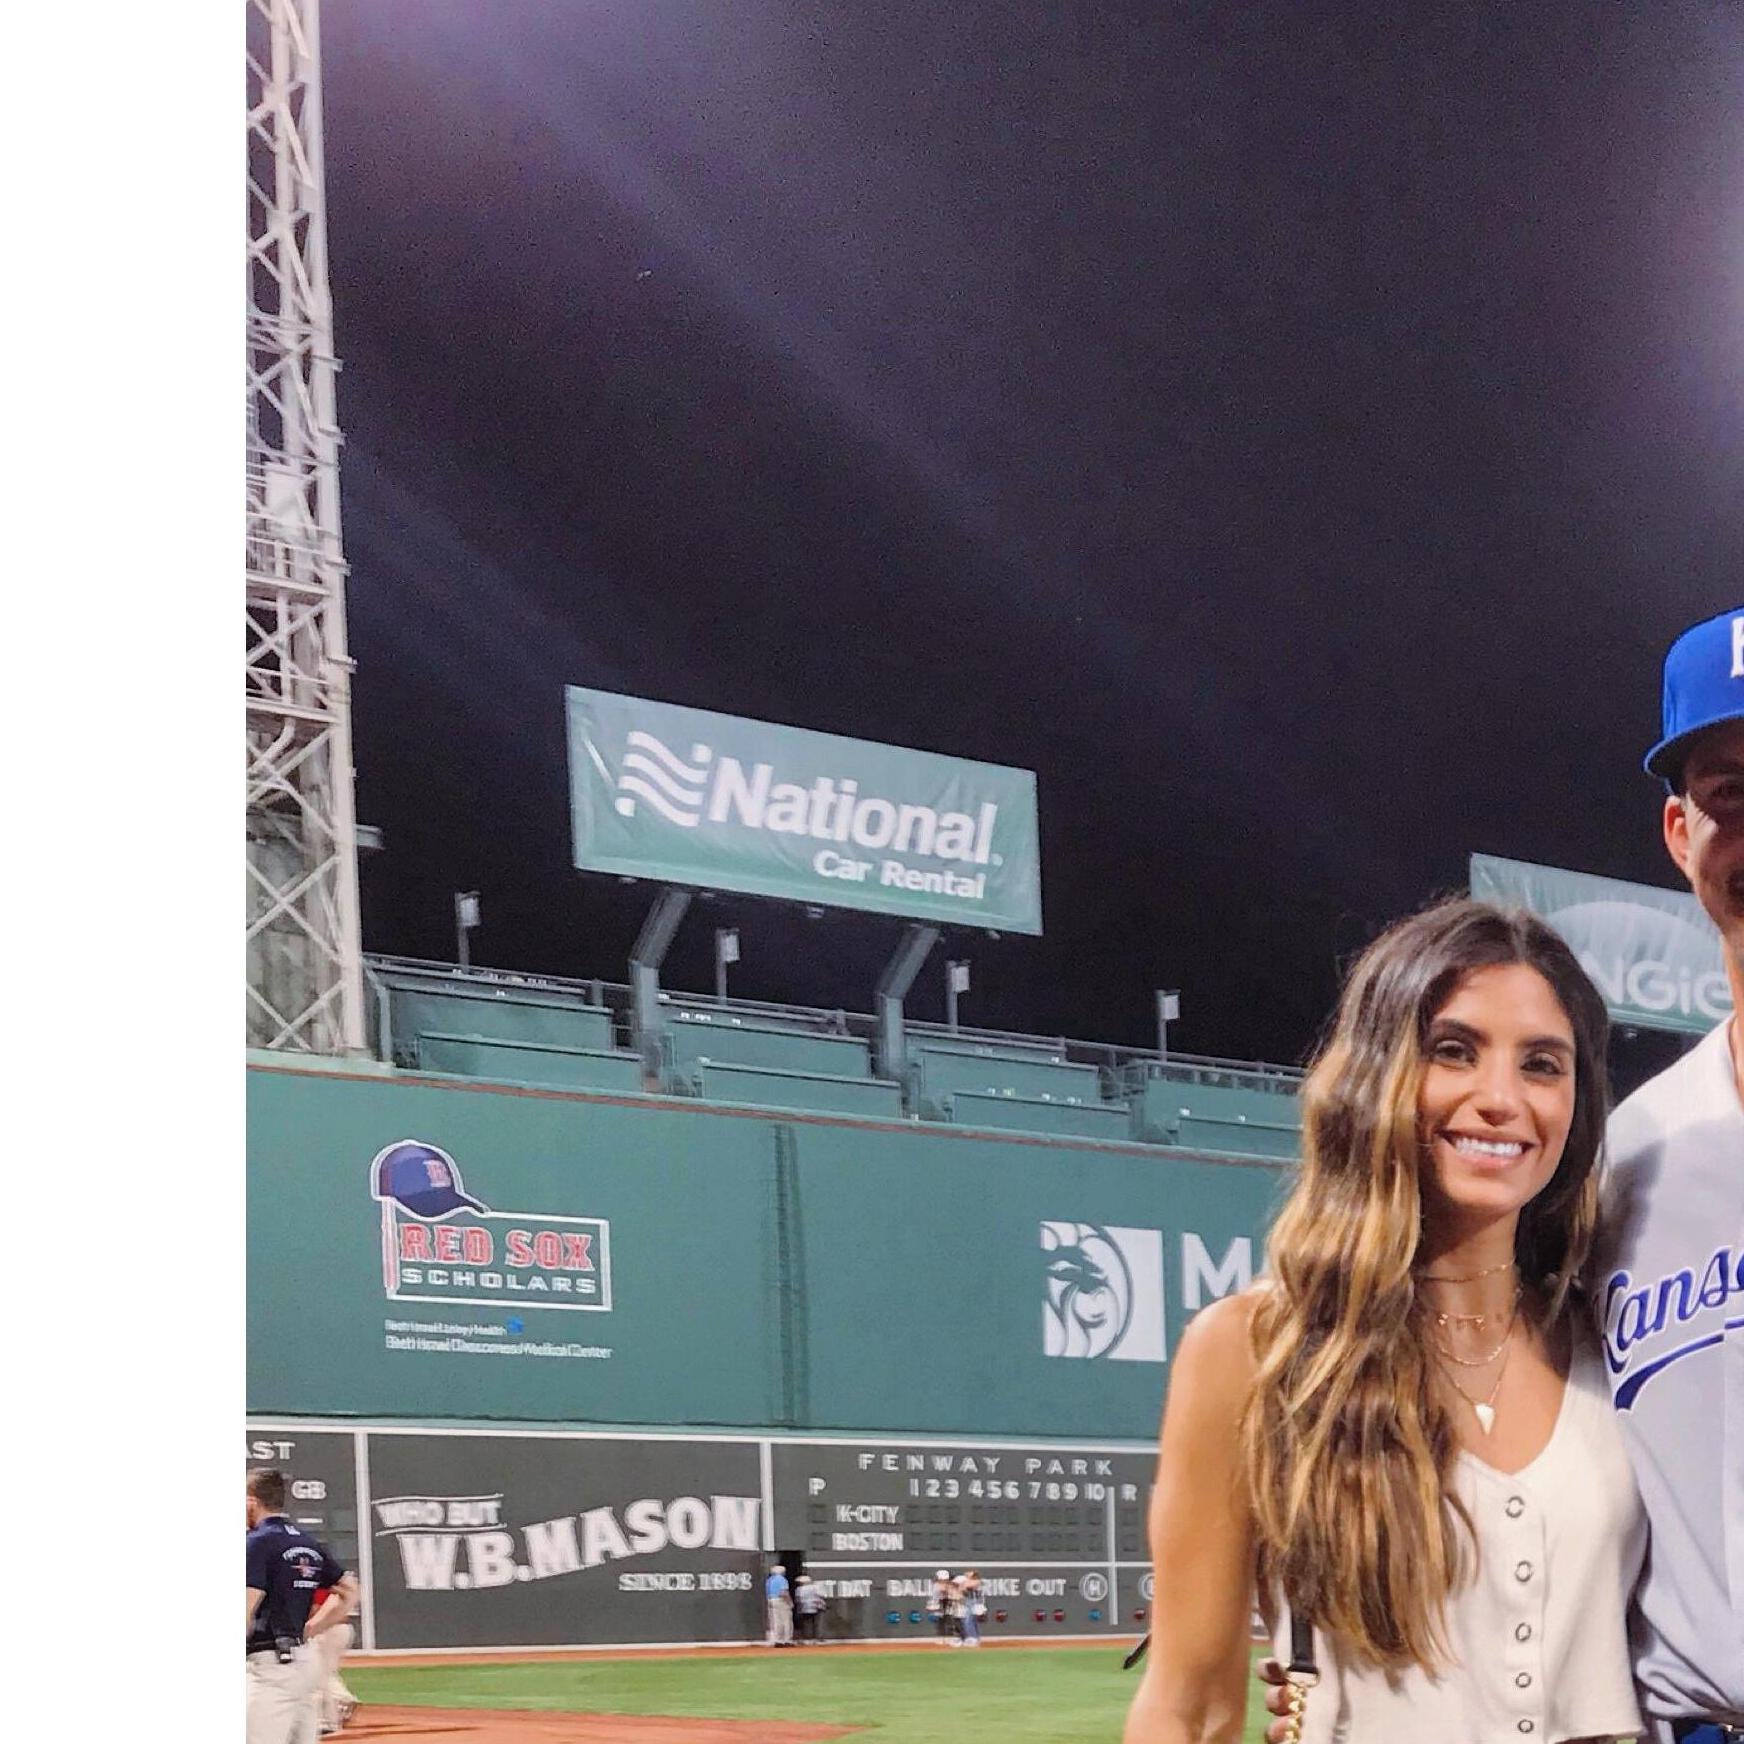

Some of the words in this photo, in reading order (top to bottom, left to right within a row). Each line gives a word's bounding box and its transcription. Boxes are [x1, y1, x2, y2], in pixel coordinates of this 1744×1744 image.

[812, 850, 873, 882] Car
[879, 859, 987, 899] Rental
[399, 1222, 493, 1265] RED
[505, 1229, 596, 1272] SOX
[401, 1267, 597, 1294] SCHOLARS
[246, 1440, 297, 1460] ST
[858, 1453, 1001, 1475] FENWAY
[1024, 1458, 1113, 1476] PARK
[291, 1480, 328, 1500] GB
[808, 1477, 827, 1496] P
[1121, 1483, 1138, 1501] R
[836, 1503, 900, 1524] K-CITY
[831, 1532, 904, 1552] BOSTON
[619, 1572, 696, 1592] SINCE
[837, 1579, 873, 1598] BAT
[1026, 1578, 1067, 1597] OUT
